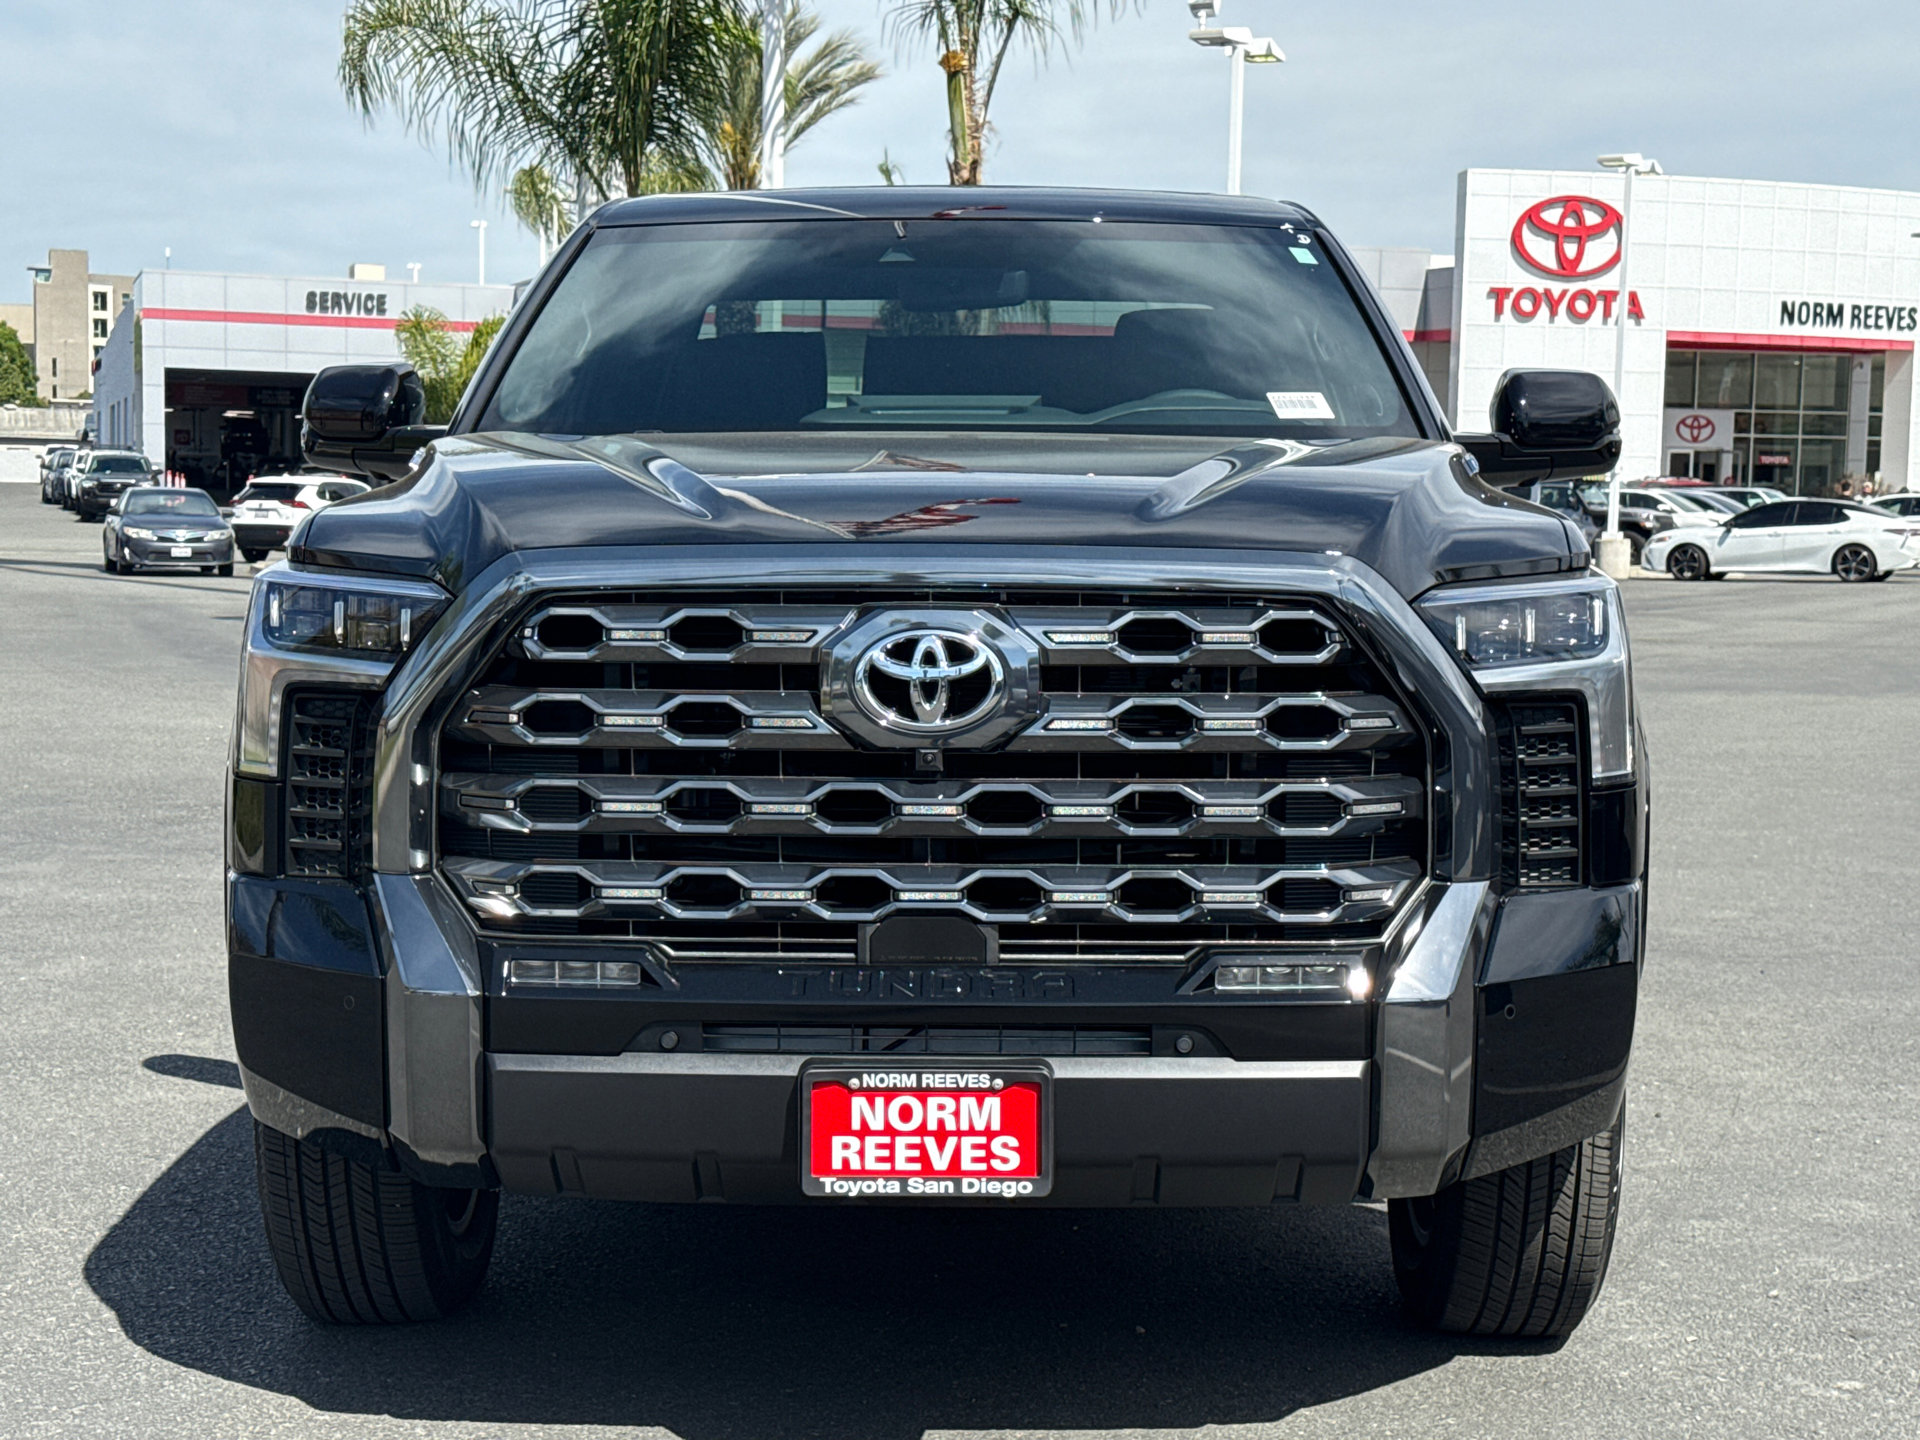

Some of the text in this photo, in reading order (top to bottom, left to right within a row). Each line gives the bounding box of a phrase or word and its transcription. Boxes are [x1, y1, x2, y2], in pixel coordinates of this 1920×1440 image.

[306, 291, 387, 316] SERVICE
[1488, 287, 1645, 321] TOYOTA
[1780, 300, 1918, 331] NORM REEVES
[778, 969, 1076, 999] TUNDRA
[862, 1073, 990, 1088] NORM REEVES
[851, 1095, 1001, 1131] NORM
[831, 1135, 1021, 1171] REEVES
[819, 1177, 1033, 1197] Toyota San Diego
